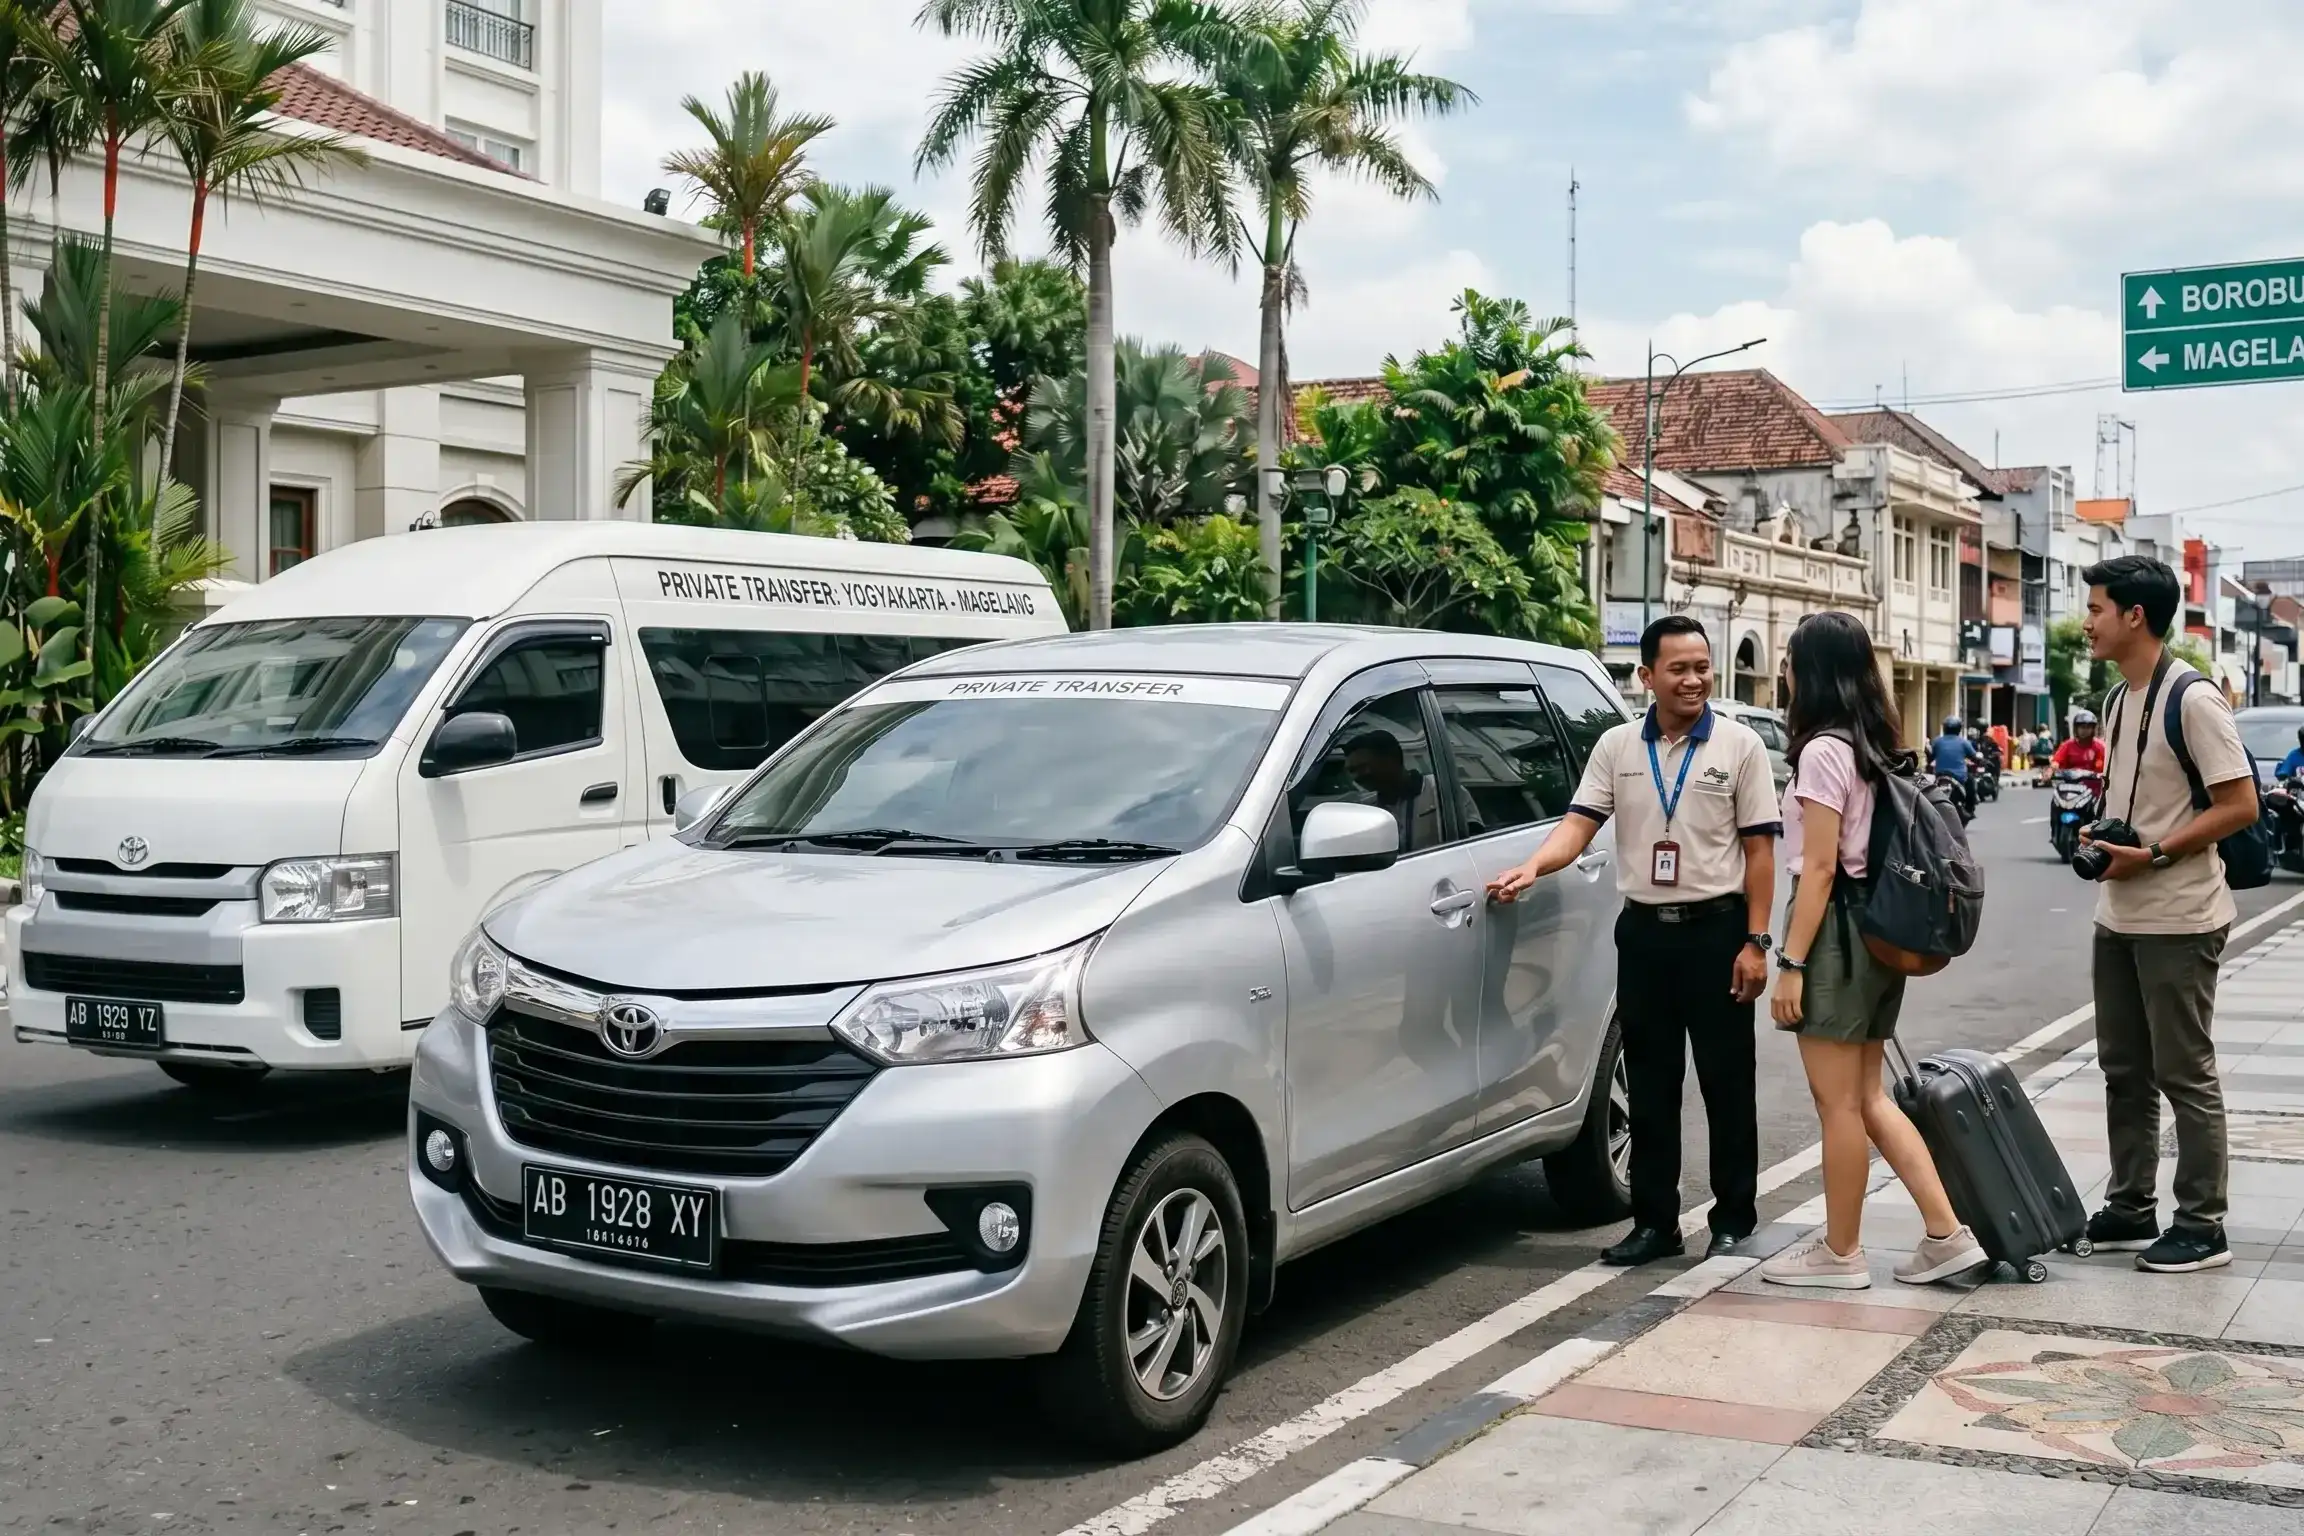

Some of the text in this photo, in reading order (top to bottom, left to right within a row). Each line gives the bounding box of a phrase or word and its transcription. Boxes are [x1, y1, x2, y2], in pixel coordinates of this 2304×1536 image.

[2182, 275, 2304, 313] BOROBU
[2184, 335, 2304, 371] MAGELA
[657, 571, 741, 600] PRIVATE
[741, 576, 841, 606] TRANSFER:
[841, 582, 948, 611] YOGYAKARTA
[956, 589, 1035, 615] MAGELANG
[949, 680, 1185, 696] PRIVATE TRANSFER
[70, 1002, 157, 1031] AB 1929 YZ
[533, 1174, 705, 1238] AB 1928 XY
